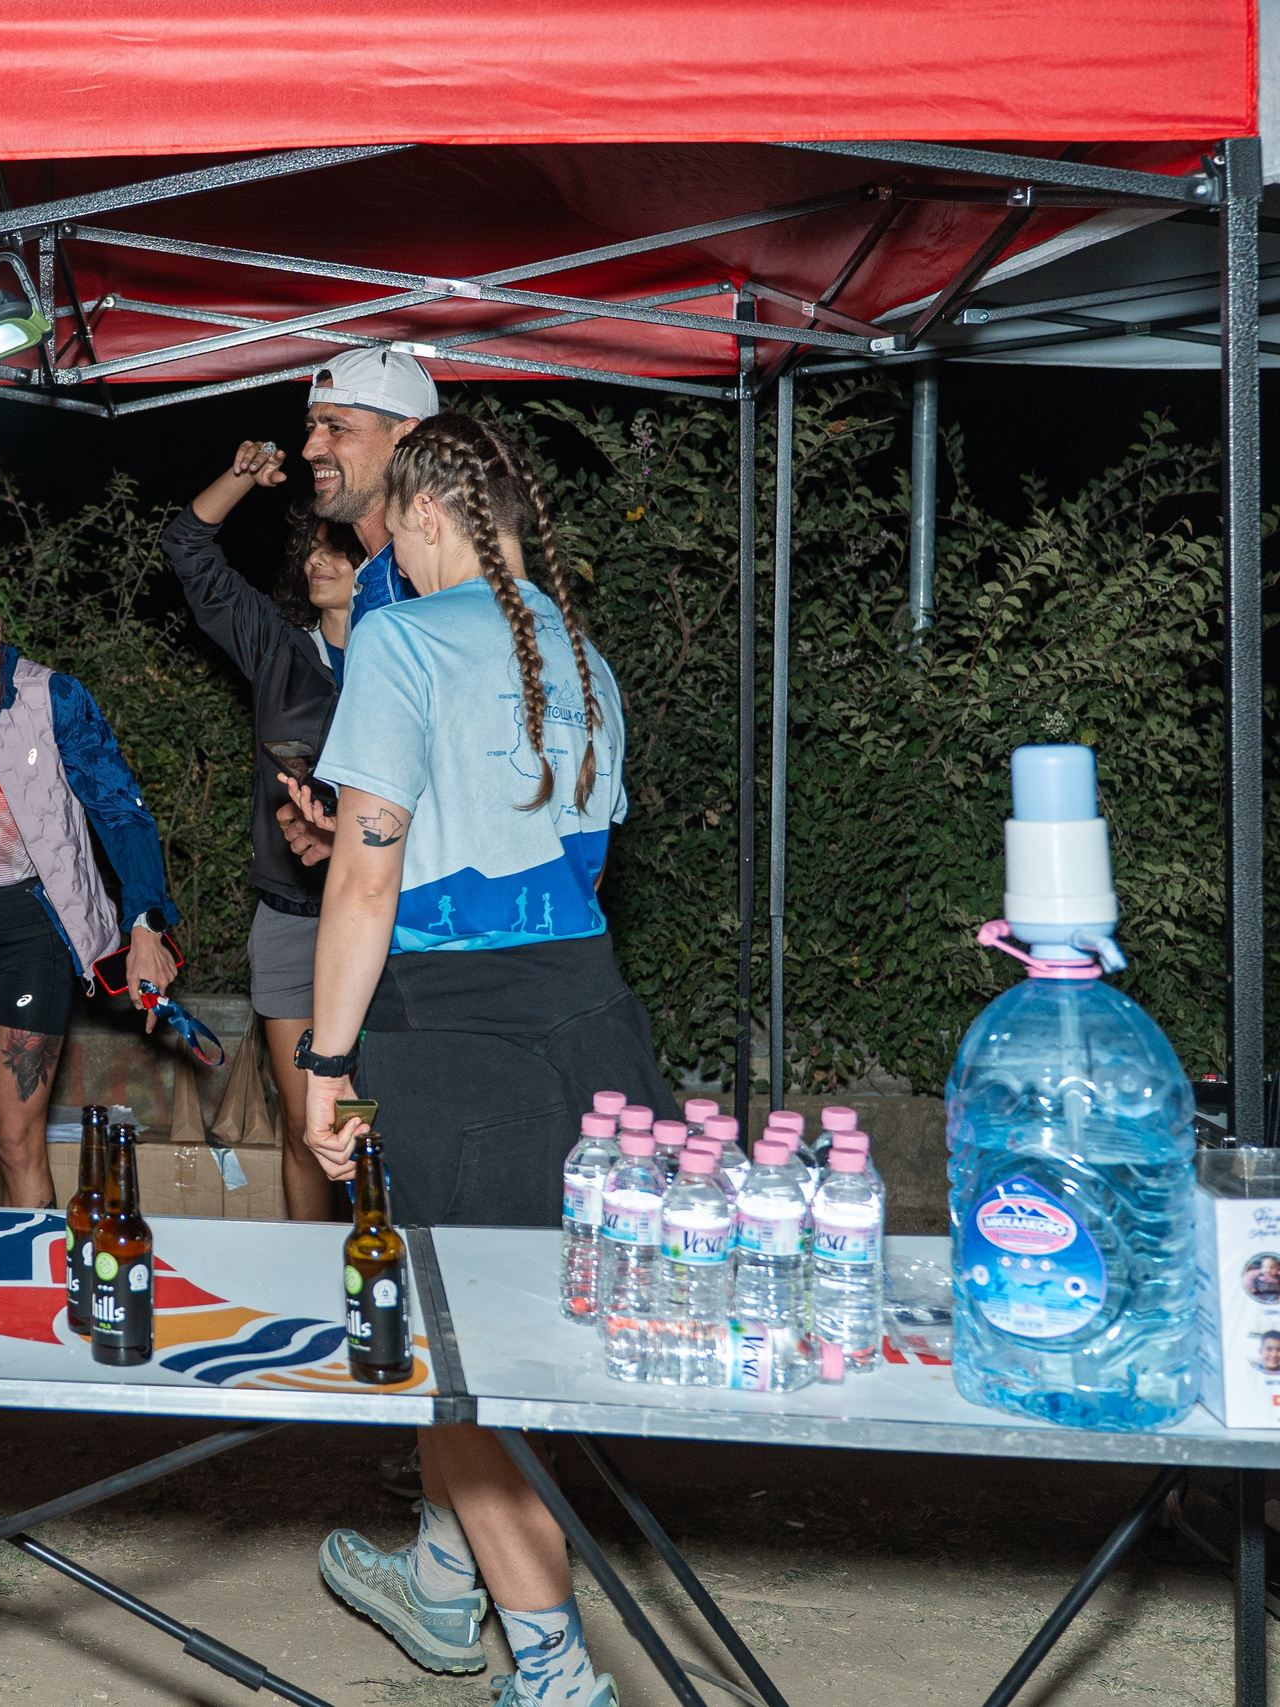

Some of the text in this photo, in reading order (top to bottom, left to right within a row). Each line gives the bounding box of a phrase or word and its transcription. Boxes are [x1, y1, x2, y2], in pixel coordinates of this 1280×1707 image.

[545, 705, 572, 721] ТОША
[264, 893, 318, 915] ARMO
[603, 1213, 619, 1230] sa
[682, 1230, 722, 1254] Vesa
[92, 1293, 125, 1322] hills
[742, 1337, 765, 1379] Vesa
